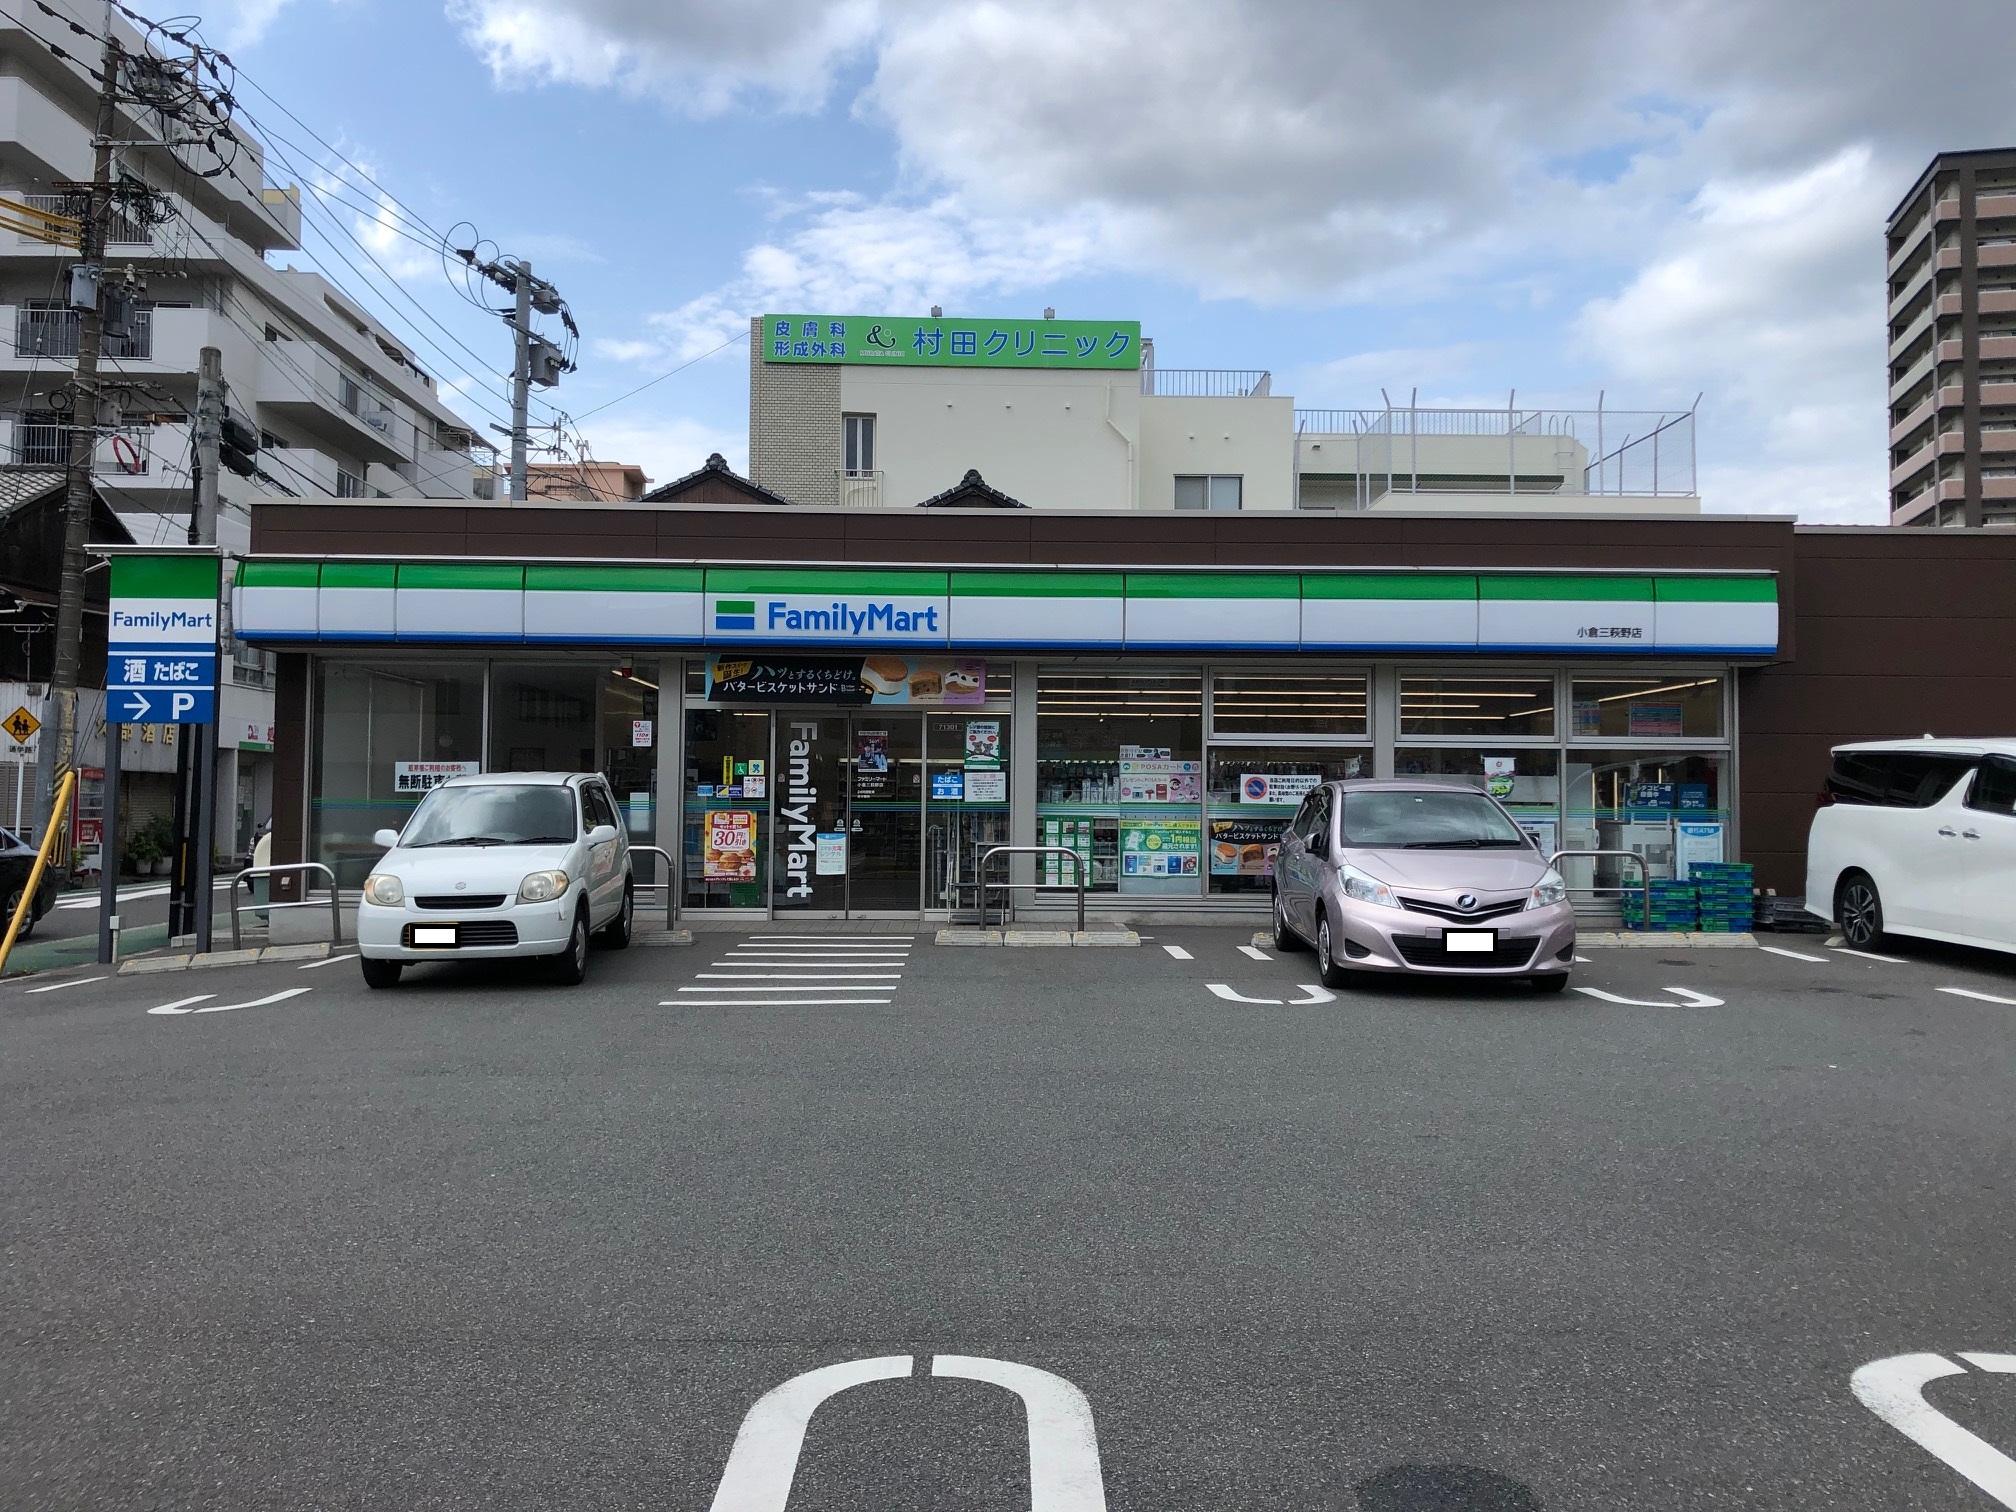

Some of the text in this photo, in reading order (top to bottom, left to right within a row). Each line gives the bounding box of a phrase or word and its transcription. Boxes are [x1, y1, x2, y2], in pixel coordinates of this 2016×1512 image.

[774, 320, 846, 338] 皮膚科
[774, 340, 846, 358] 形成外科
[912, 326, 1131, 358] 村田クリニック
[113, 611, 212, 632] FamilyMart
[768, 602, 938, 635] FamilyMart
[1577, 626, 1643, 638] 小倉三萩野店
[123, 658, 199, 683] 酒 たばこ
[751, 665, 856, 681] ハッとするくちどけ。
[723, 681, 838, 694] バタービスケットサンド
[172, 692, 195, 720] P
[1140, 763, 1182, 771] POSAカード
[937, 776, 958, 784] たばこ
[781, 722, 818, 898] FamilyMart
